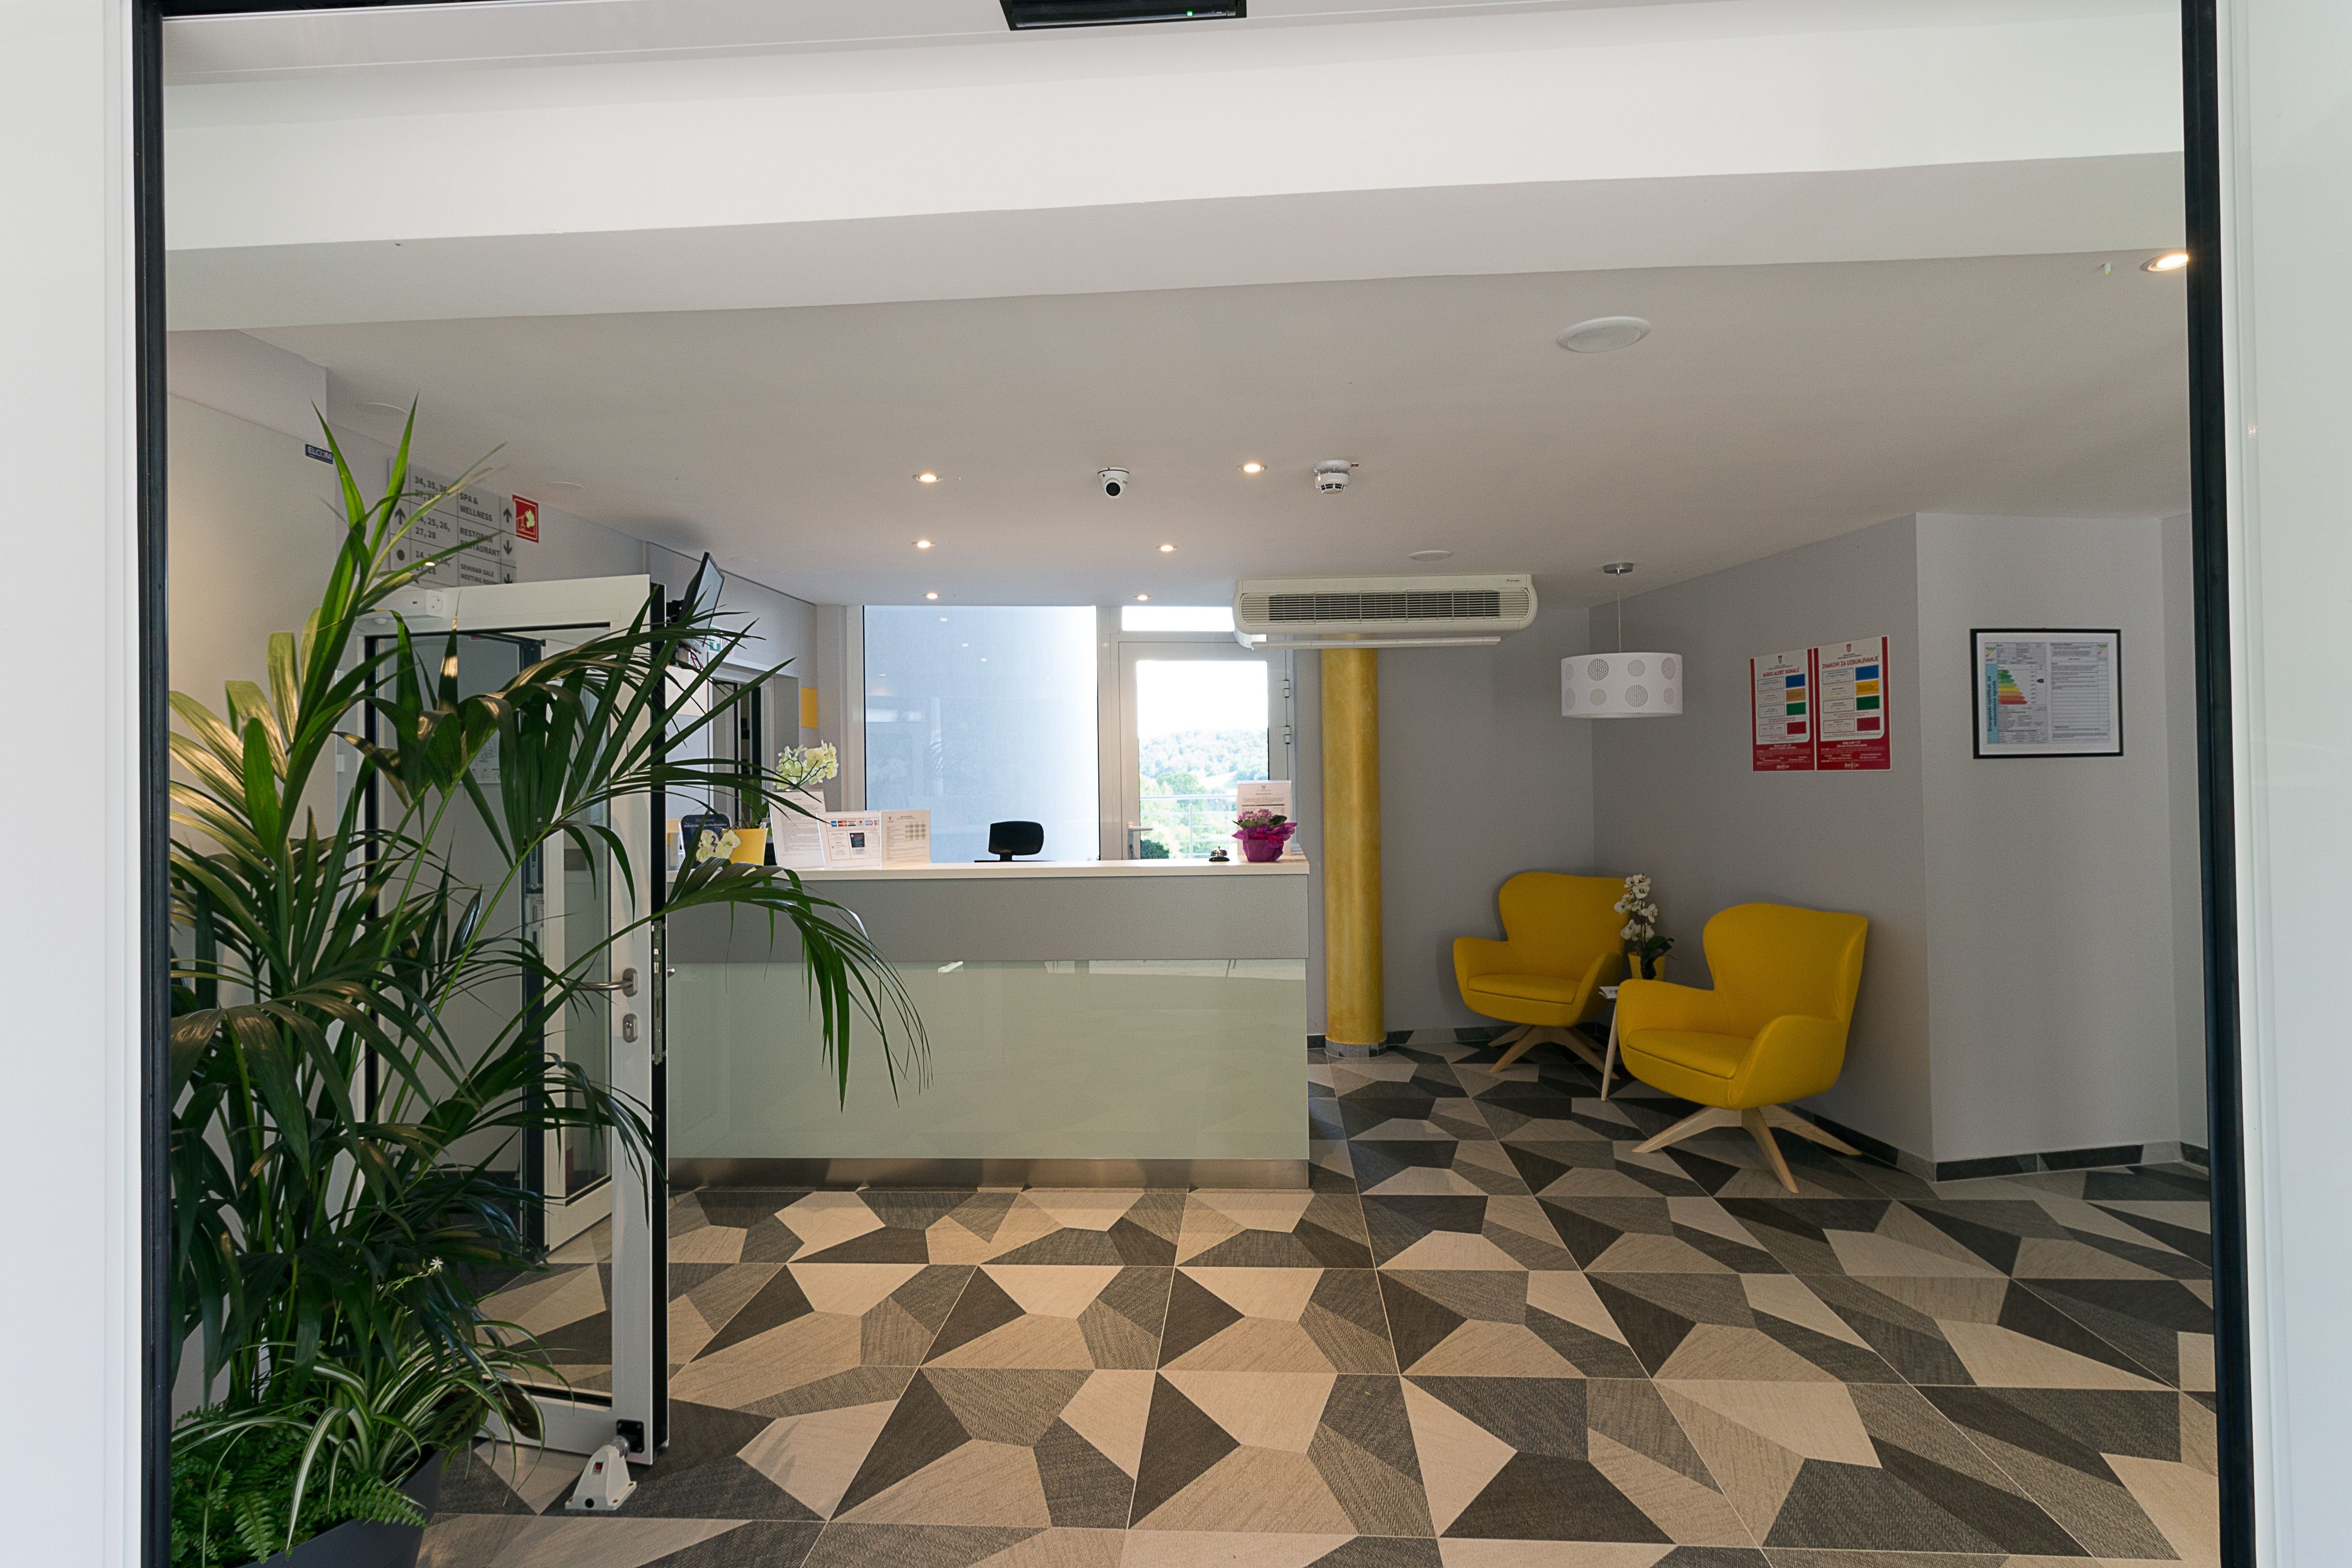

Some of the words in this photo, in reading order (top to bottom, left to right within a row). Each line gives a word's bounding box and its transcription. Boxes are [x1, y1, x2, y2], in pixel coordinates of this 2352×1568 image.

[308, 446, 332, 460] ELCOM
[415, 476, 426, 487] 34,
[427, 480, 438, 492] 35,
[460, 492, 472, 503] SPA
[460, 505, 492, 522] WELLNESS
[428, 518, 438, 529] 25,
[439, 522, 450, 532] 26,
[415, 527, 426, 538] 27,
[428, 531, 436, 539] 28
[461, 564, 482, 574] SEMINAR
[461, 574, 482, 583] MEETING
